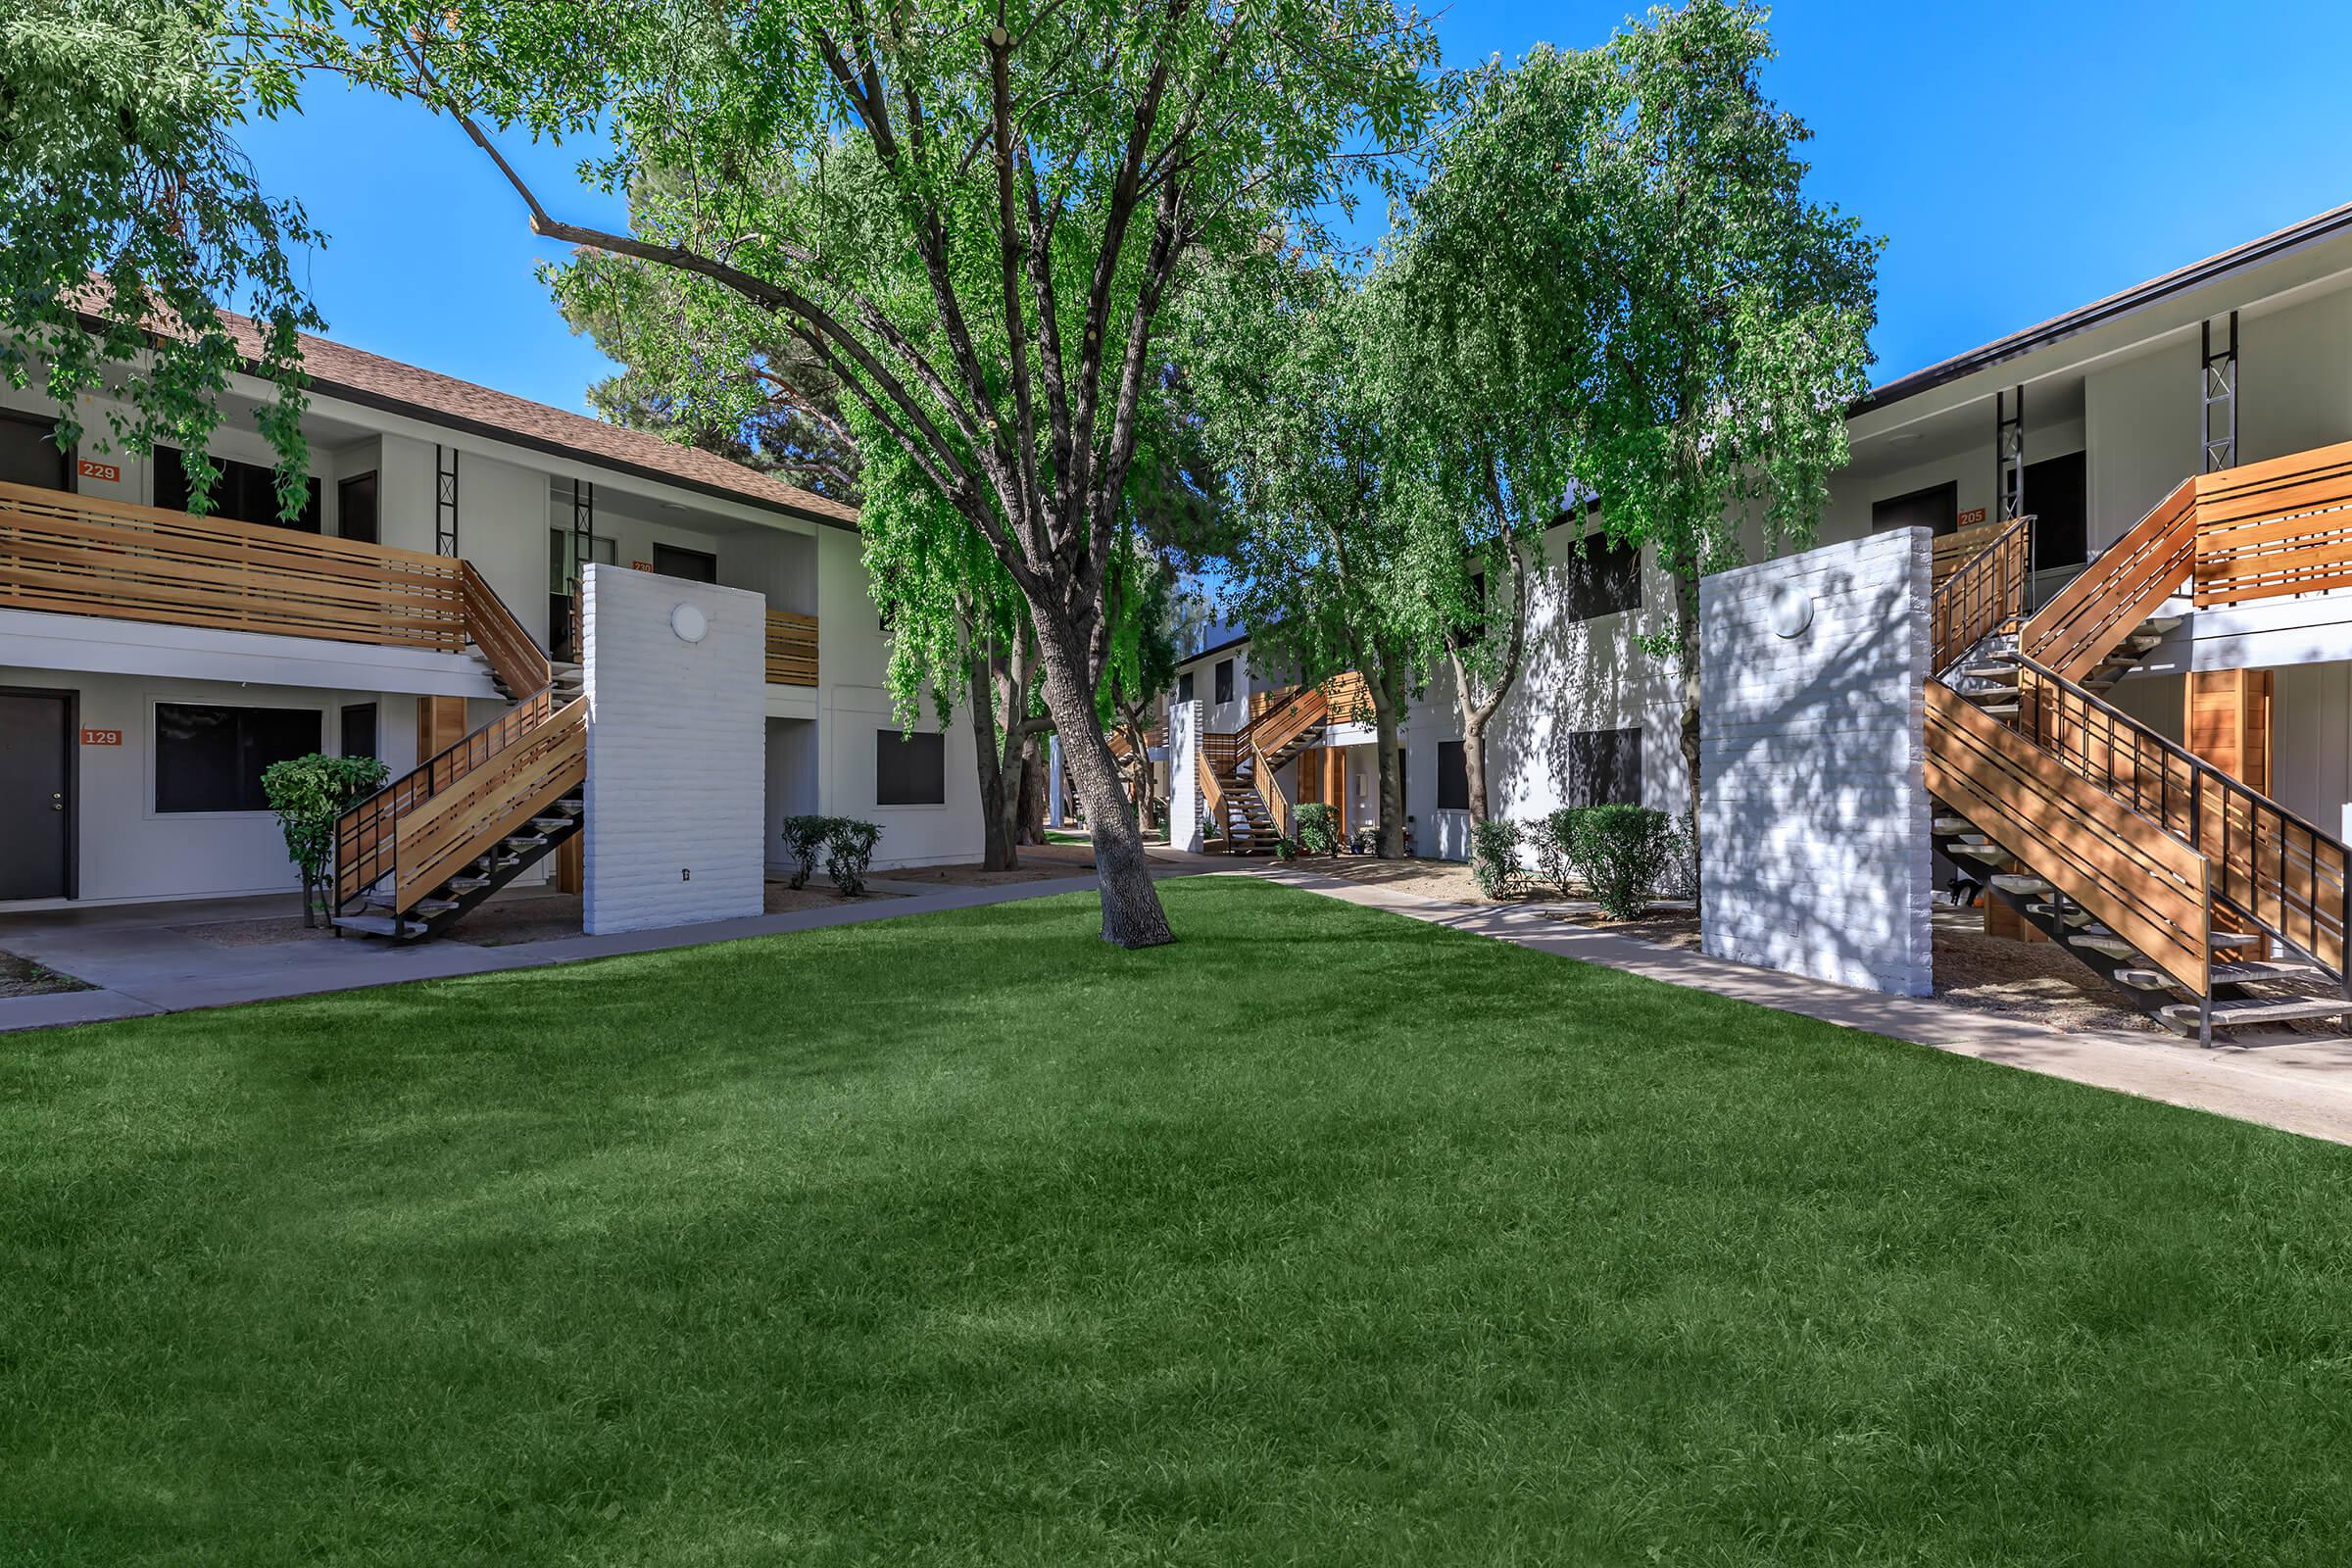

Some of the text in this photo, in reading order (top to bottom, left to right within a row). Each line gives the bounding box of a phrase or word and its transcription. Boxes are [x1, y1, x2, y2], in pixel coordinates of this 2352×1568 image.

[83, 464, 115, 479] 229
[1961, 511, 1983, 525] 205
[86, 732, 117, 744] 129
